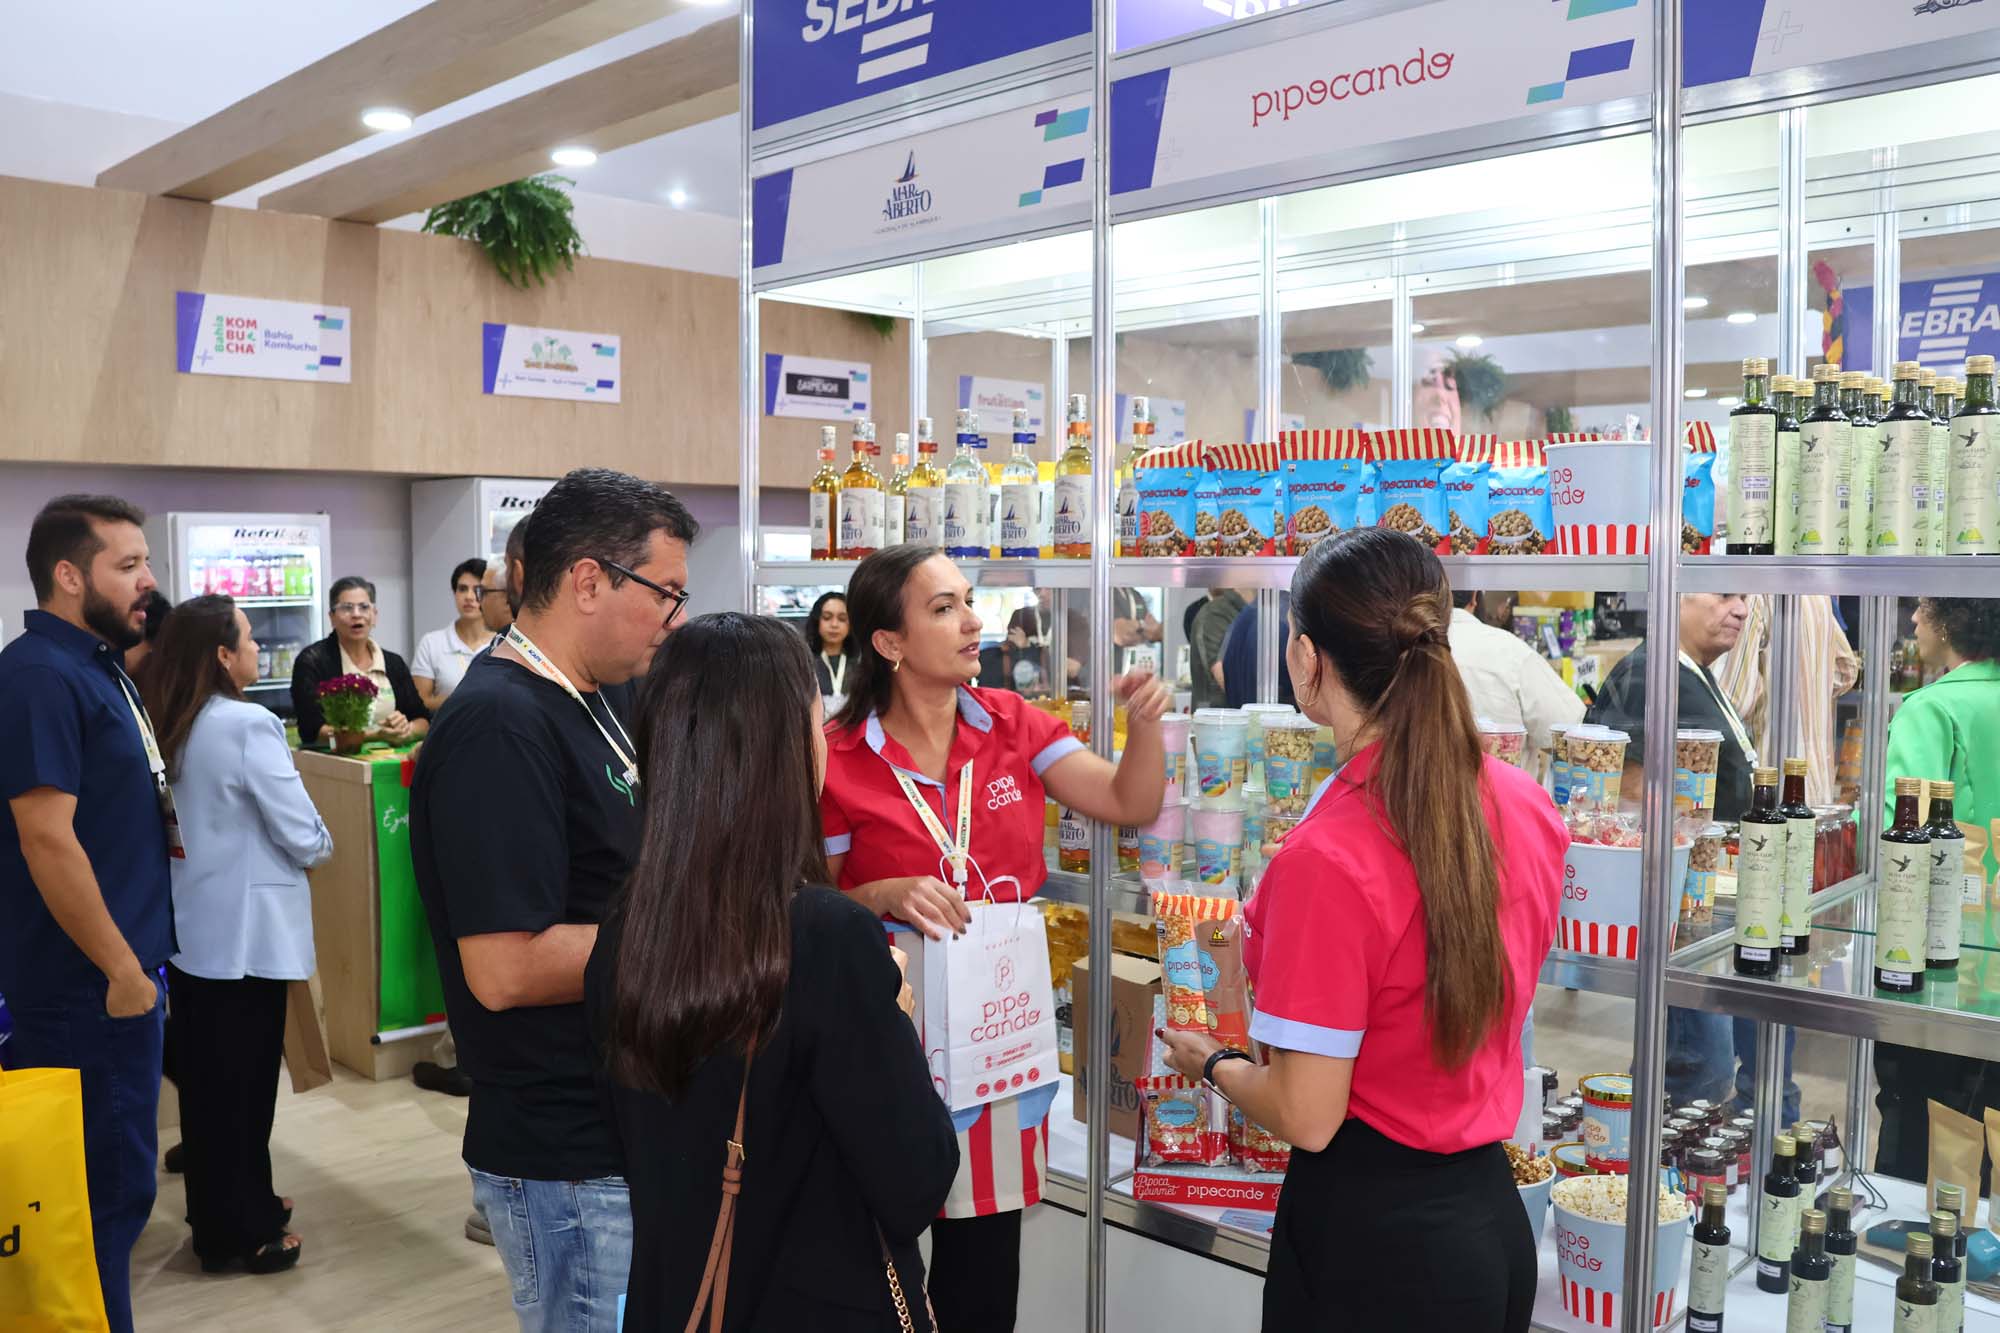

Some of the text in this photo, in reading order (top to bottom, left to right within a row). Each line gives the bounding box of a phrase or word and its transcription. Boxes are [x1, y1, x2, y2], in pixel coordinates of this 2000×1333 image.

[882, 189, 931, 220] ABERTO
[225, 317, 257, 329] KOM
[226, 342, 255, 354] CHA
[981, 991, 1031, 1023] pipo
[970, 1009, 1041, 1043] cando
[1187, 1185, 1264, 1200] pipocando
